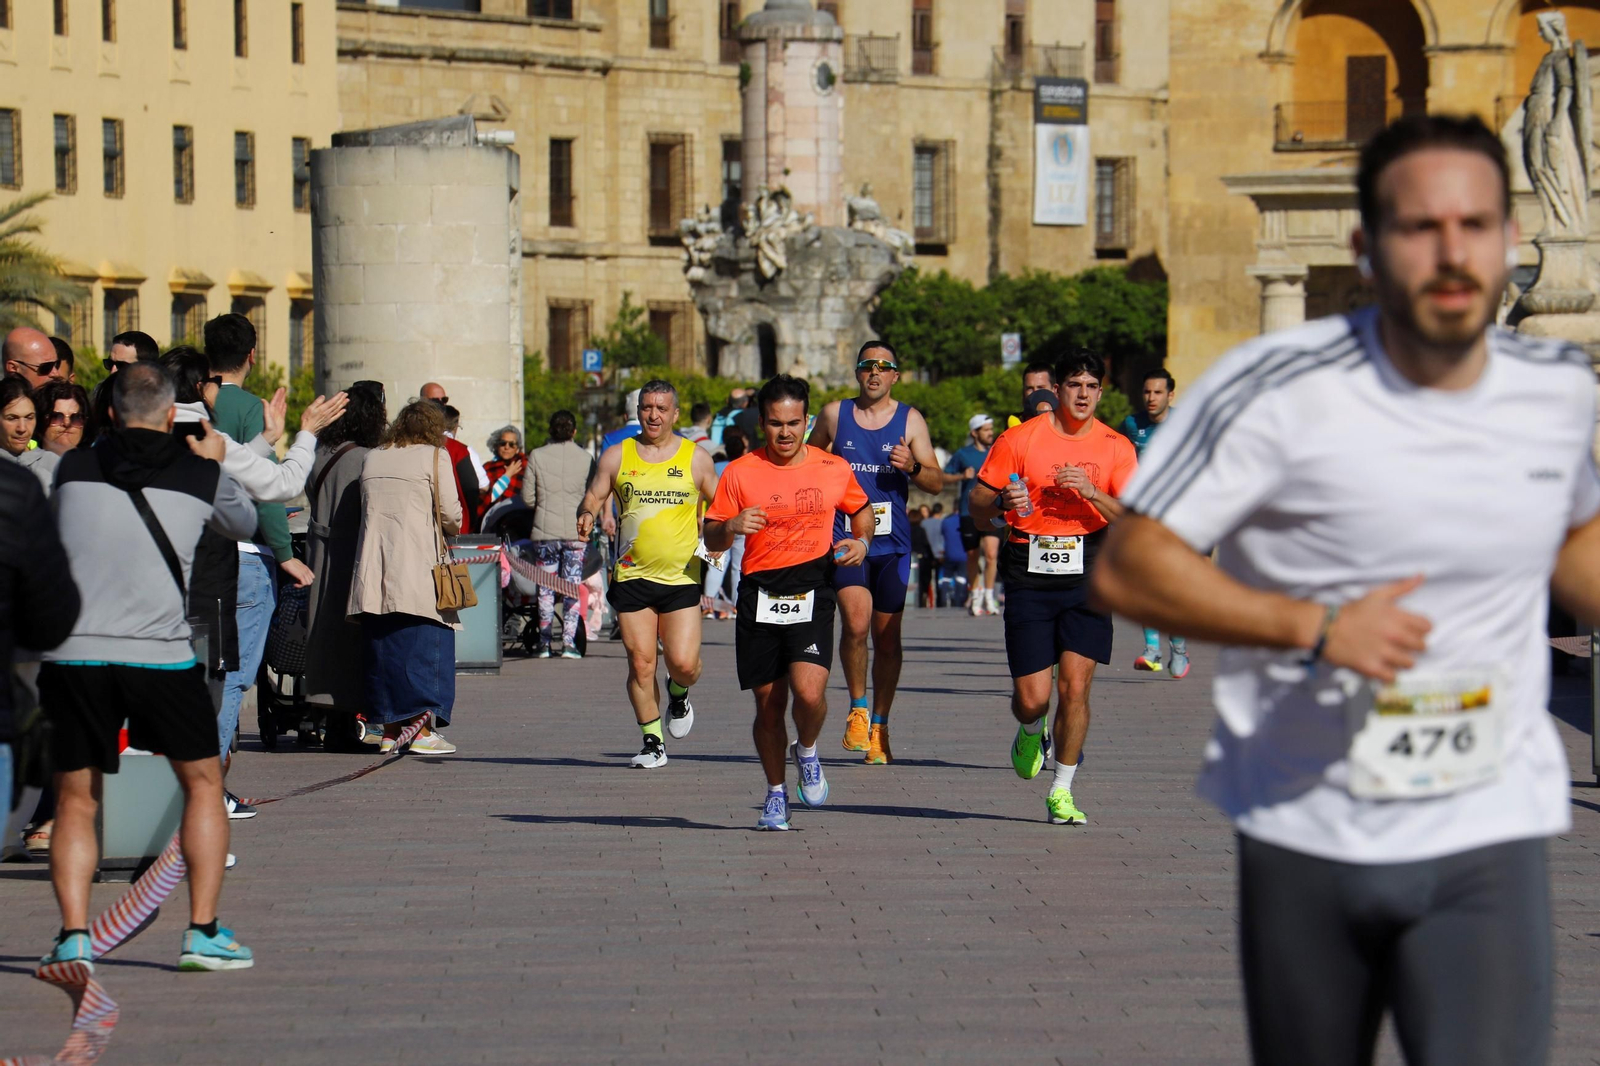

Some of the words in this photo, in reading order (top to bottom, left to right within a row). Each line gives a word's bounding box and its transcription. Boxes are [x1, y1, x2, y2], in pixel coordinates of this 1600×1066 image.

[585, 351, 598, 370] P
[850, 462, 896, 474] OTASIERRA
[654, 490, 690, 498] ATLETISMO
[1040, 552, 1070, 563] 493
[769, 603, 801, 614] 494
[1386, 720, 1476, 758] 476
